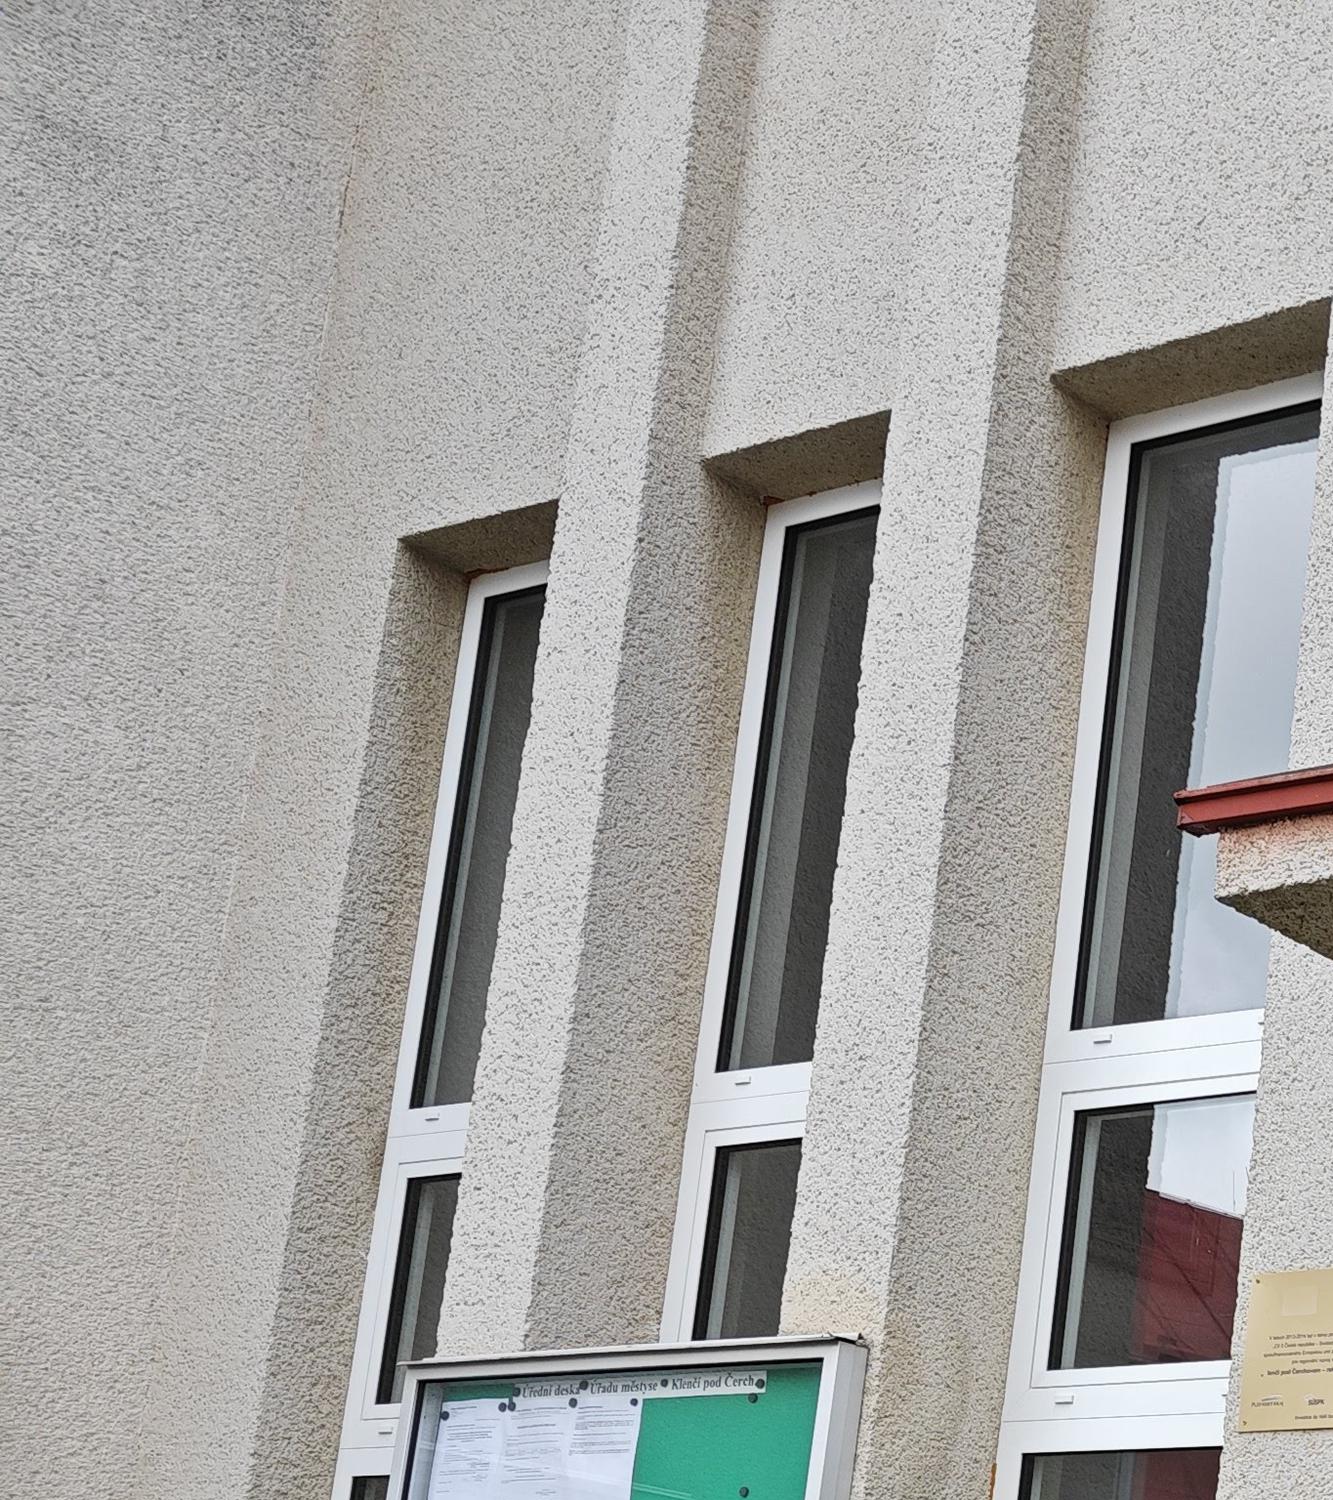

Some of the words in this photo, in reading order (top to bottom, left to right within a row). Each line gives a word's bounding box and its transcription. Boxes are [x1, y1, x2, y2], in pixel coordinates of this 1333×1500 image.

[554, 1383, 580, 1397] deska
[621, 1379, 658, 1395] městyse
[671, 1375, 701, 1390] Klenčí
[703, 1378, 722, 1394] pod
